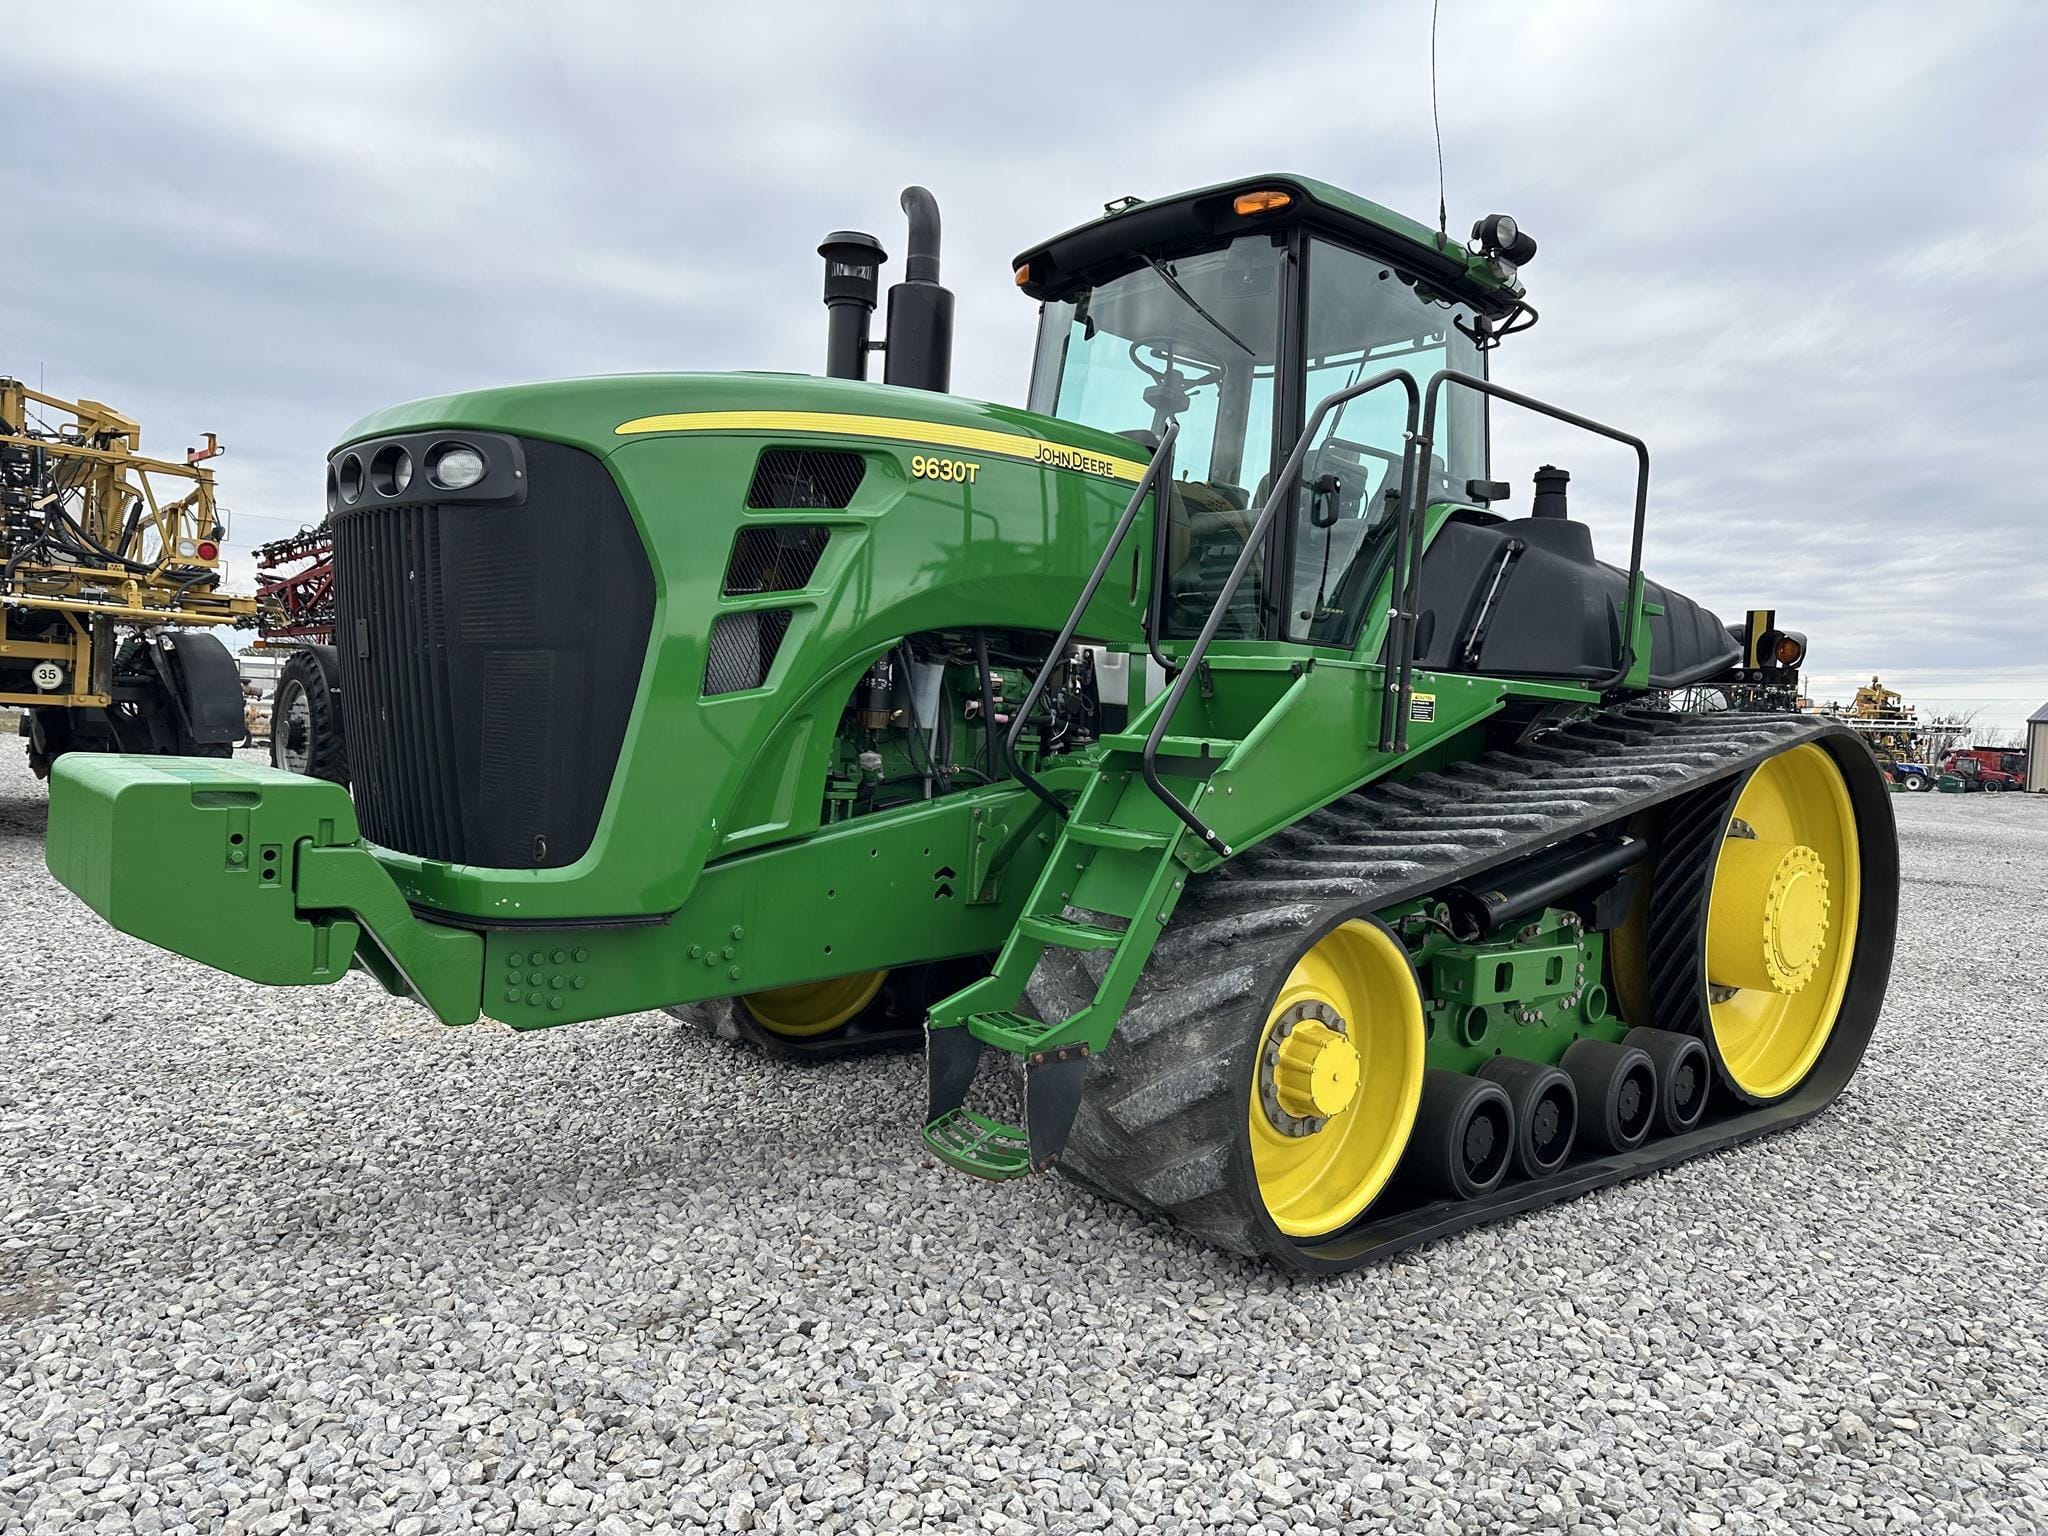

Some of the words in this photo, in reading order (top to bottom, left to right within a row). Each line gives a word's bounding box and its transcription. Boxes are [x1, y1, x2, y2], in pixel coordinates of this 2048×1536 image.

[911, 455, 981, 484] 9630T
[1034, 443, 1071, 467] JOHN
[1072, 452, 1114, 475] DEERE
[39, 669, 56, 680] 35
